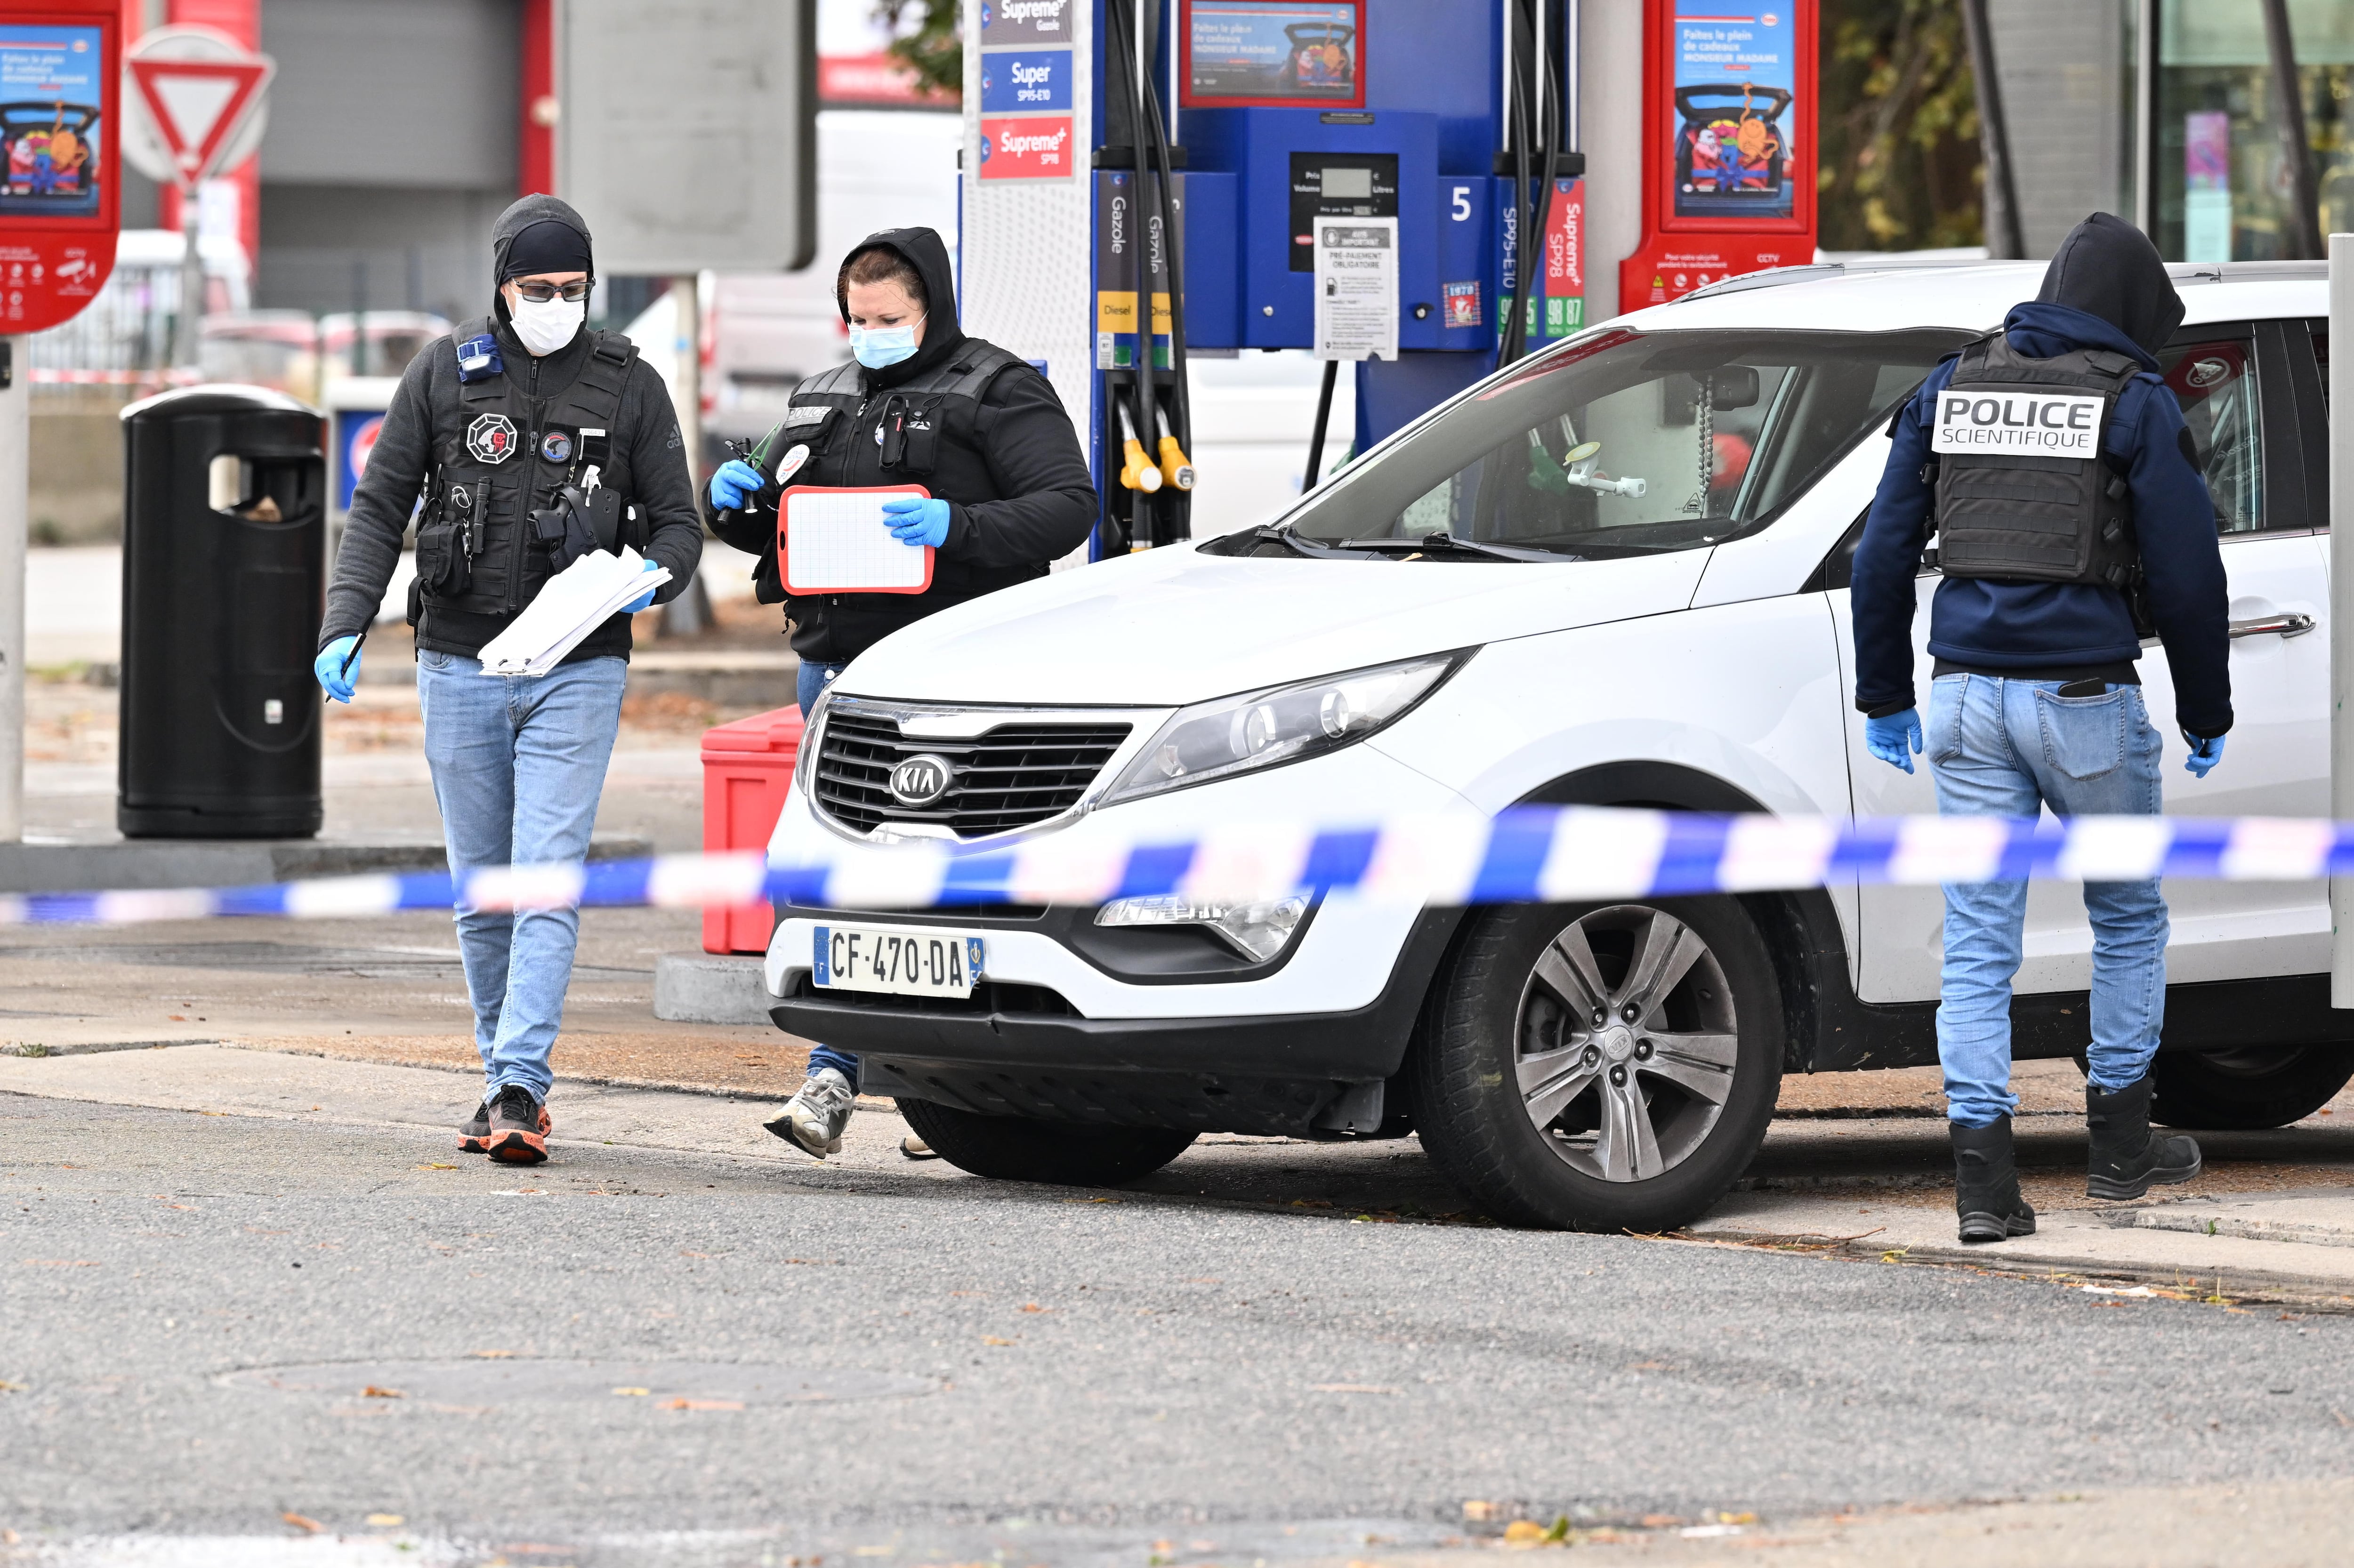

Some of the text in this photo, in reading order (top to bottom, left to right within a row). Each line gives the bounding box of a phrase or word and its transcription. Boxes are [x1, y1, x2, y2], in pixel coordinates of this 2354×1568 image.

[1683, 29, 1753, 42] Faites le plein
[1683, 41, 1740, 51] de cadeaux
[1012, 62, 1051, 88] Super
[1017, 89, 1051, 101] SP95-E10
[1001, 127, 1067, 158] Supreme+
[1040, 153, 1059, 165] SP98
[1294, 184, 1321, 192] Volume
[1451, 186, 1471, 222] 5
[1112, 196, 1127, 254] Gazole
[1502, 207, 1517, 289] SP95-E10
[1549, 233, 1564, 278] SP98
[1563, 202, 1582, 287] Supreme+
[1757, 253, 1781, 263] CCTV
[1104, 305, 1131, 316] Diesel
[1151, 306, 1172, 317] Diese
[1500, 299, 1513, 325] 9
[1548, 299, 1582, 325] 98 87
[787, 407, 831, 420] POLICE
[1943, 398, 2095, 429] POLICE
[1942, 429, 2090, 450] SCIENTIFIQUE
[898, 767, 935, 793] KIA
[818, 962, 824, 974] F
[832, 932, 963, 987] CF-470-DA
[1611, 1036, 1628, 1051] KIA
